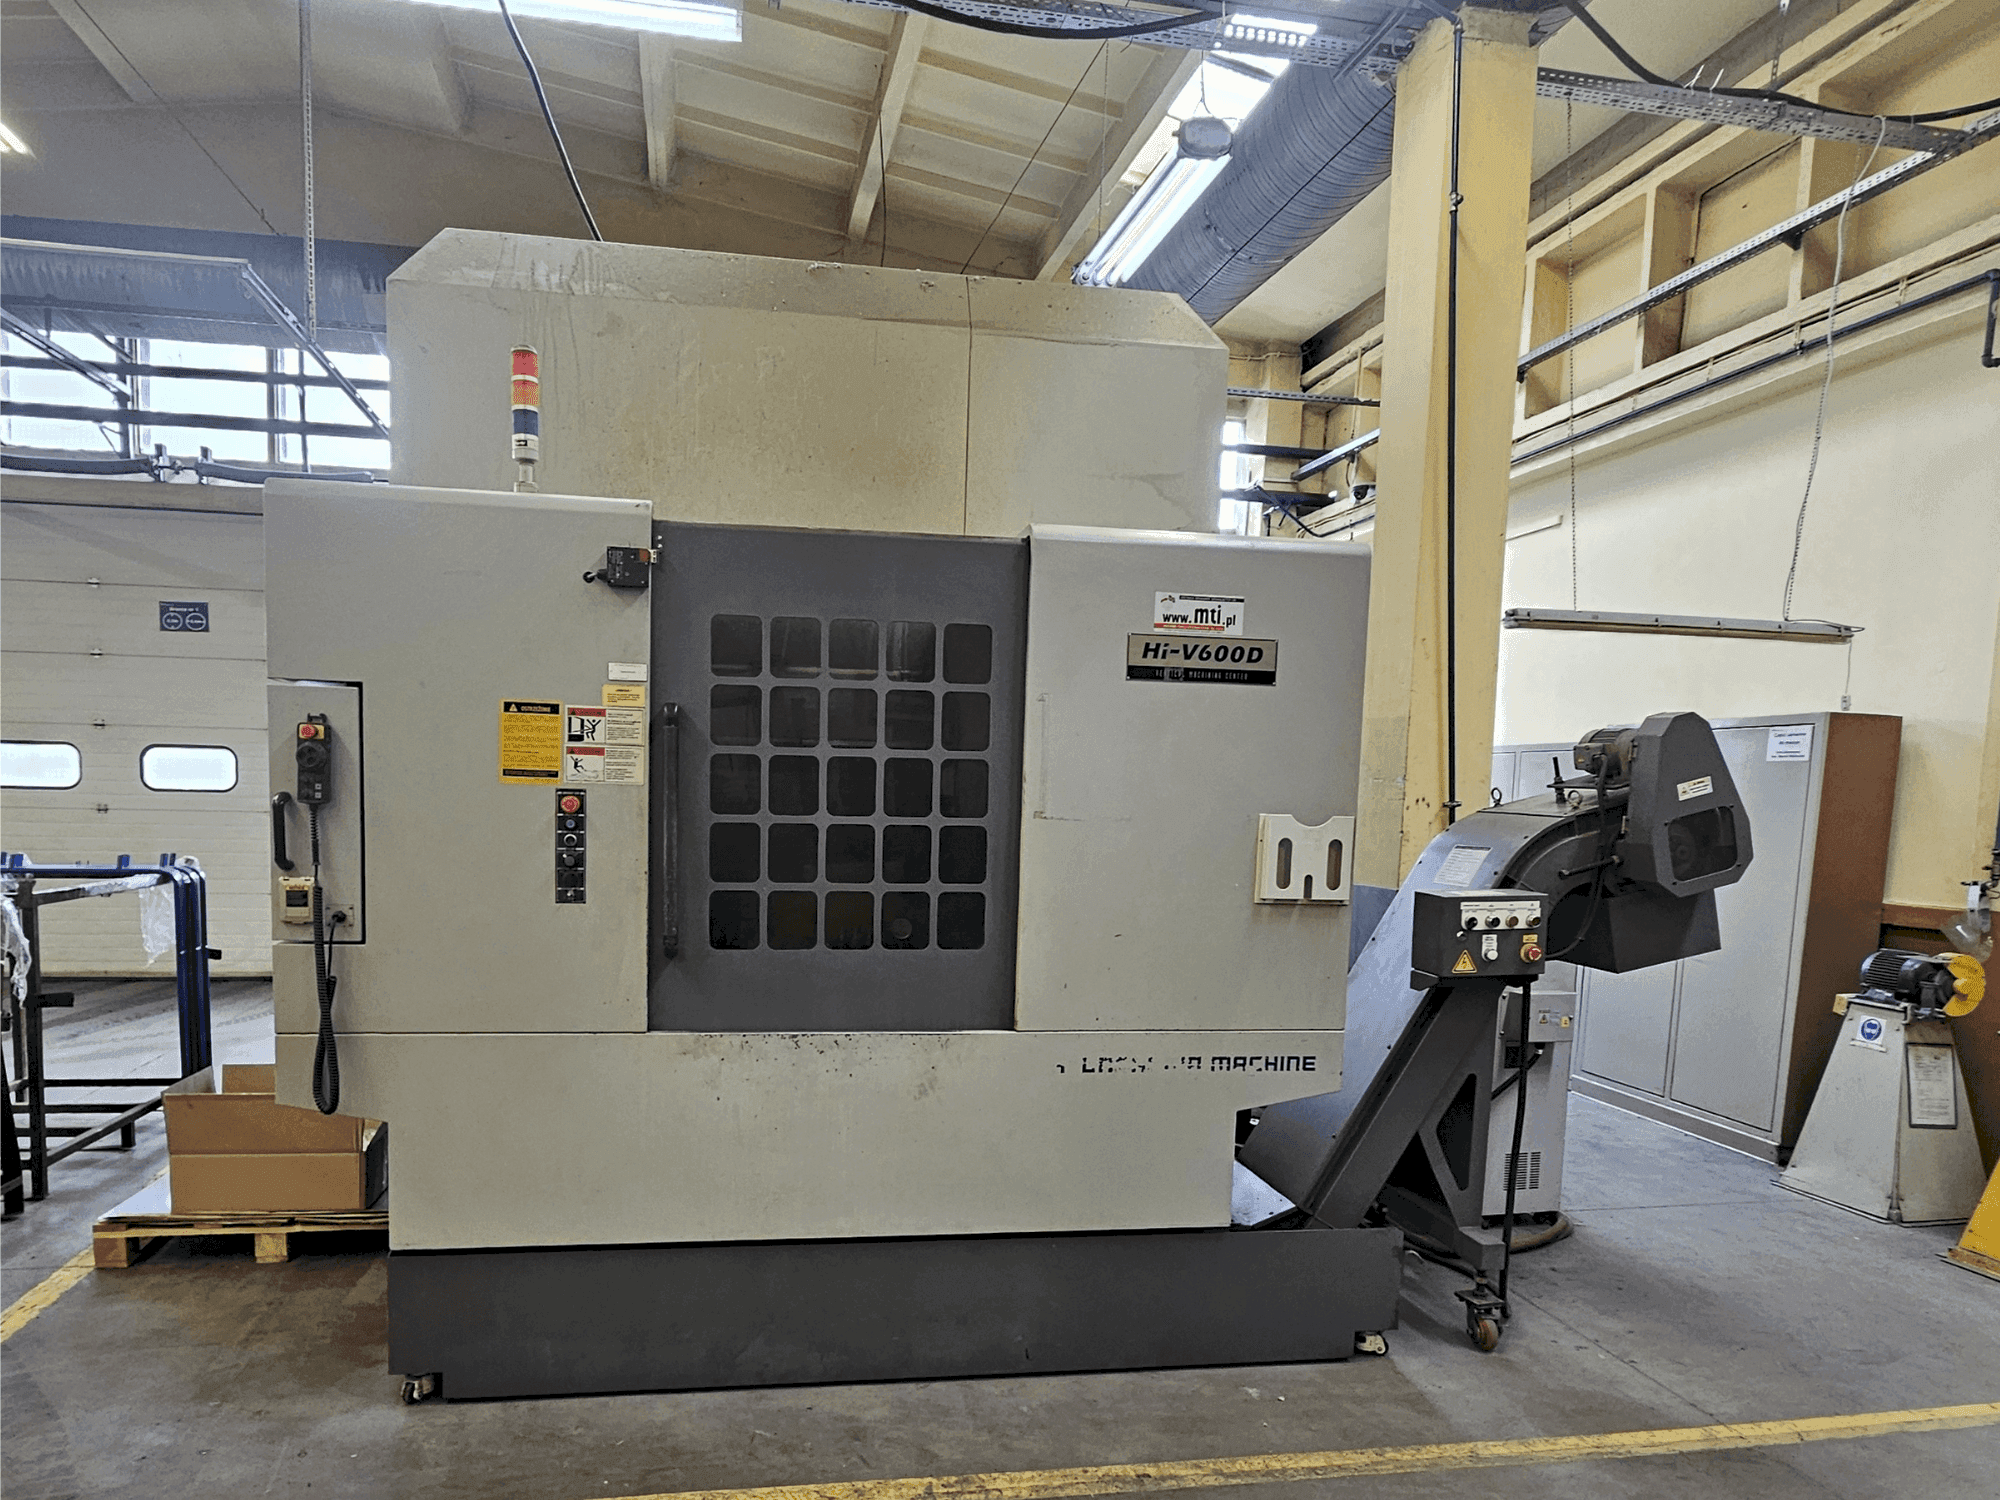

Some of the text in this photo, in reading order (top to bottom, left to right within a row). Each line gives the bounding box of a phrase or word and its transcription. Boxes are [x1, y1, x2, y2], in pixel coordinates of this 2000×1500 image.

[1162, 604, 1236, 628] www.mti.pl
[1142, 642, 1264, 664] Hi-V600D
[1211, 1055, 1316, 1072] MACHINE
